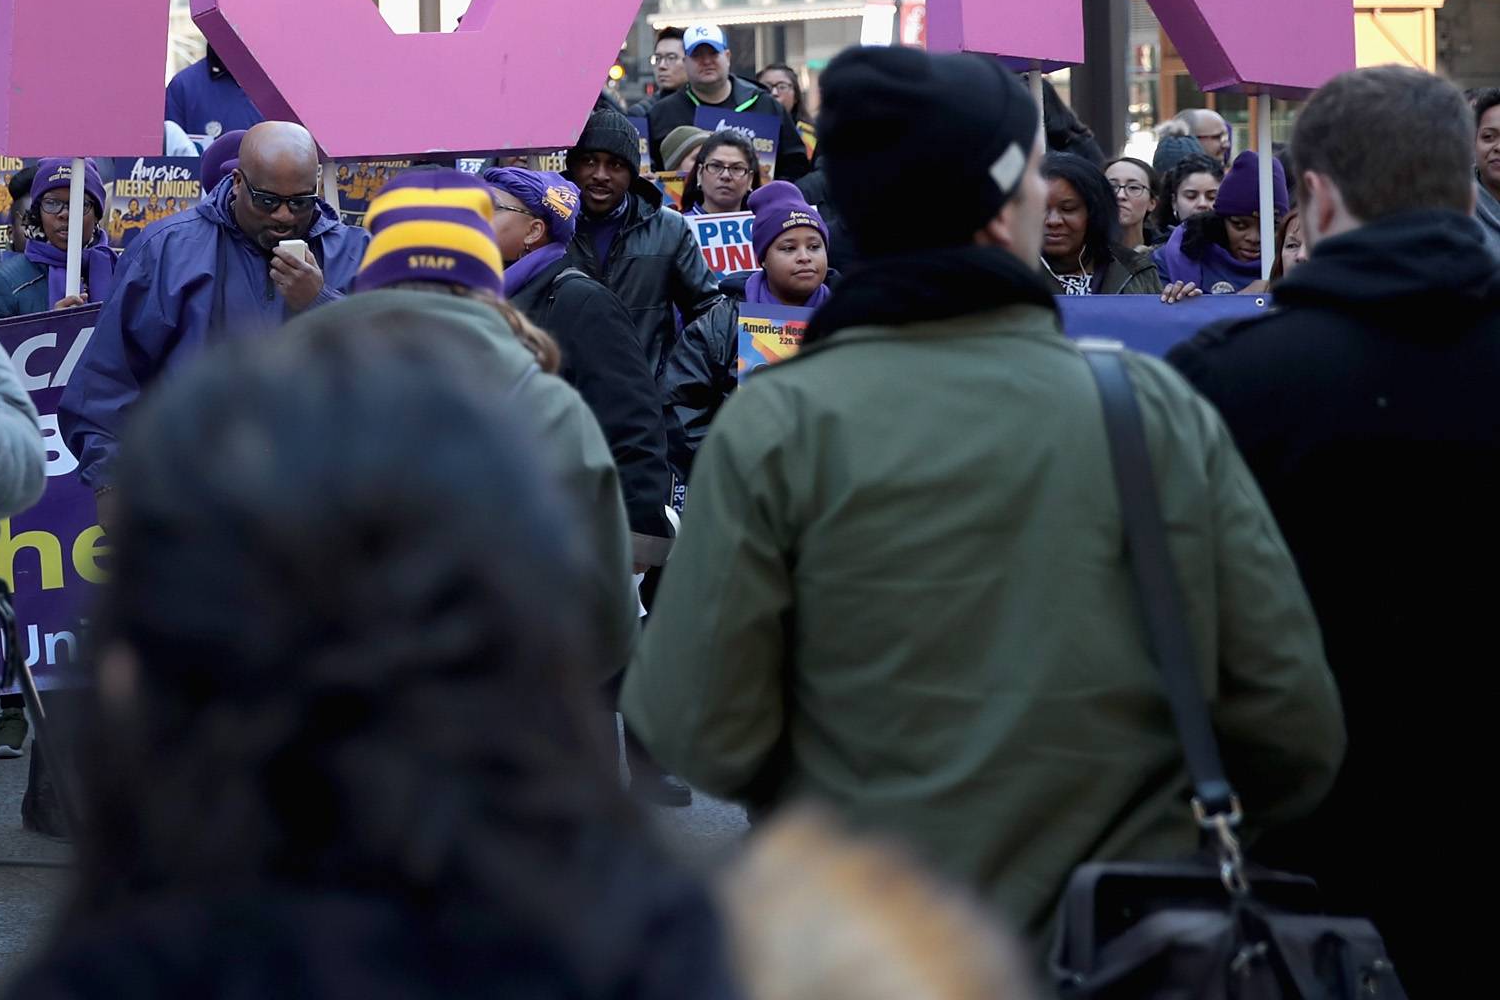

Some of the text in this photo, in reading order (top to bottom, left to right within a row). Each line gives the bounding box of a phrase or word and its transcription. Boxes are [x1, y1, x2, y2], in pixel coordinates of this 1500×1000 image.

[130, 157, 192, 191] America
[115, 179, 200, 198] NEEDS UNIONS
[697, 218, 755, 247] PRO
[408, 255, 456, 269] STAFF
[742, 322, 805, 336] America Nee
